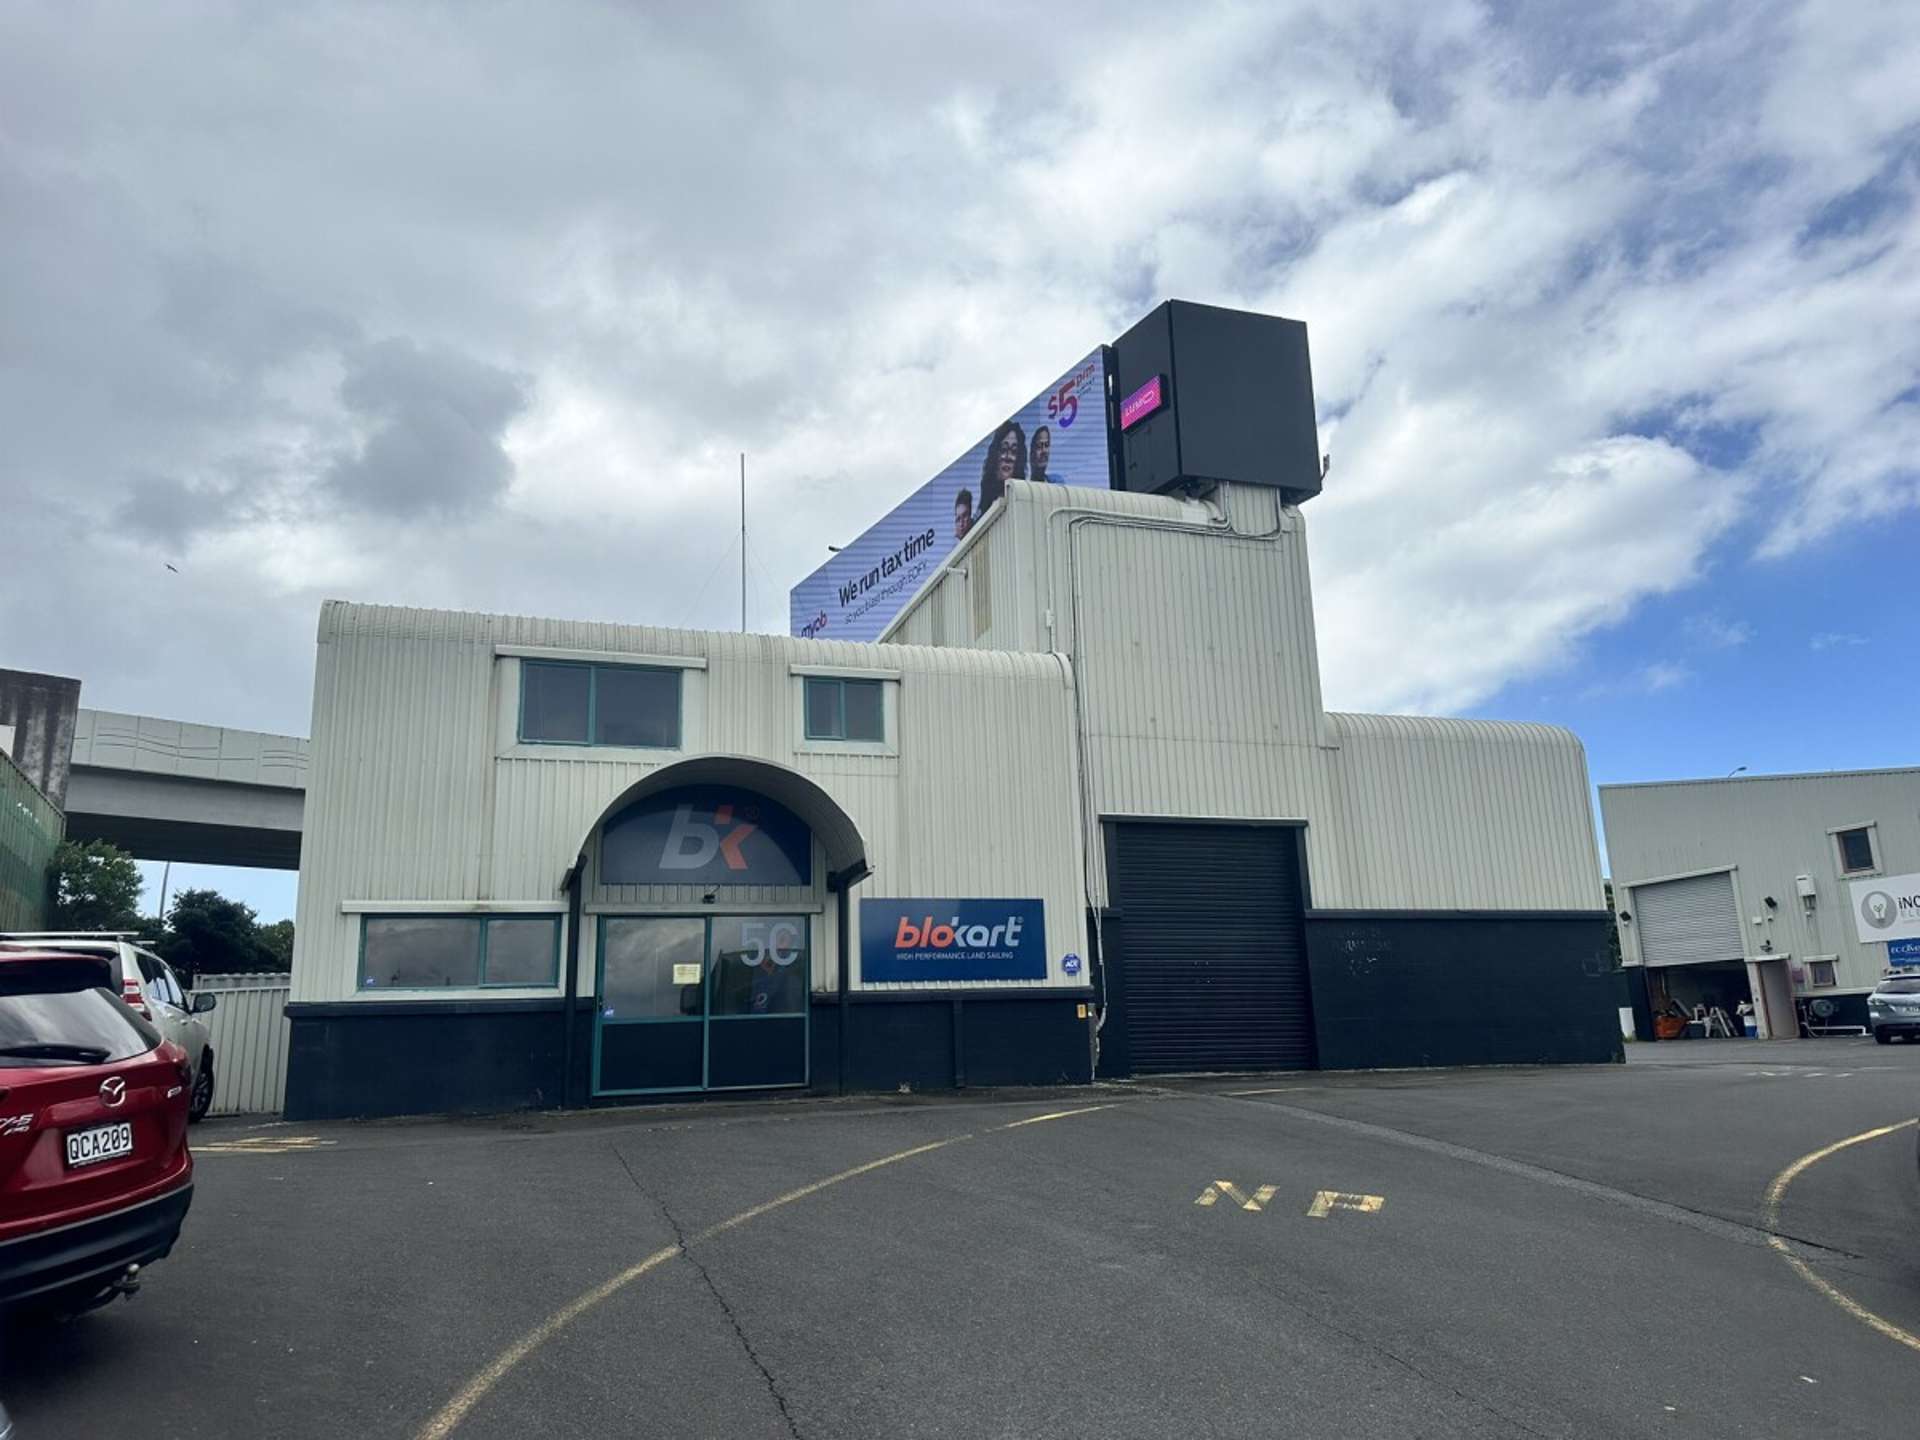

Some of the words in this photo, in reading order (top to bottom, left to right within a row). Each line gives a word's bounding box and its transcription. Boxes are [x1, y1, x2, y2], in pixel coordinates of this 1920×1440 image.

[1048, 378, 1077, 428] $5
[839, 580, 858, 608] We
[860, 567, 880, 594] run
[881, 551, 903, 578] tax
[904, 528, 935, 562] time
[740, 923, 798, 967] 5C
[895, 916, 1024, 947] blokart
[897, 951, 913, 961] HIGH
[915, 951, 965, 960] PERFORMANCE
[967, 951, 985, 960] LAND
[987, 951, 1014, 960] SAILING
[69, 1127, 129, 1160] QCA209
